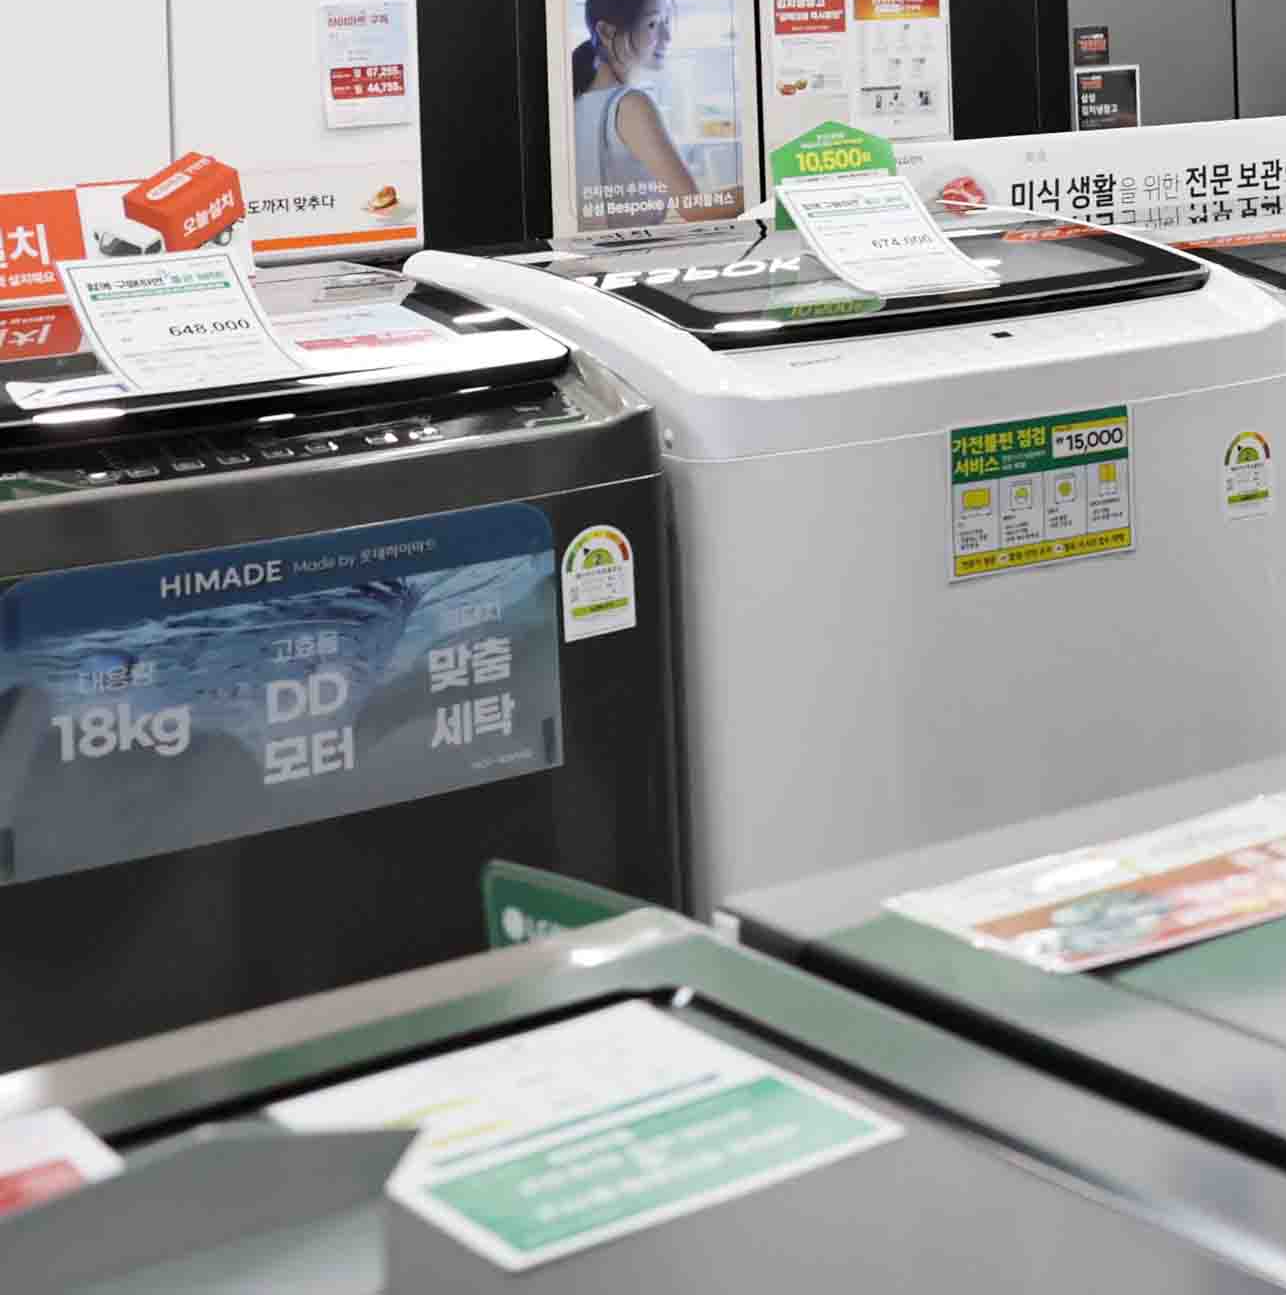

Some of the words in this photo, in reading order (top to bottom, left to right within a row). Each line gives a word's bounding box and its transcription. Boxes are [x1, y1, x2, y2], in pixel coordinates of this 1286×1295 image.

[607, 198, 665, 217] Bespoke
[1011, 178, 1060, 211] 미식
[1066, 173, 1137, 210] 생활을
[1143, 174, 1180, 202] 위한
[1185, 164, 1233, 198] 전문
[0, 223, 49, 267] 치
[955, 458, 1001, 476] 서비스
[160, 560, 283, 600] HIMADE
[292, 554, 336, 573] Made
[338, 554, 356, 570] by
[430, 636, 513, 694] 맞춤
[266, 671, 348, 725] DD
[431, 691, 516, 749] 세탁
[51, 701, 192, 762] 18kg
[263, 725, 355, 786] 모터
